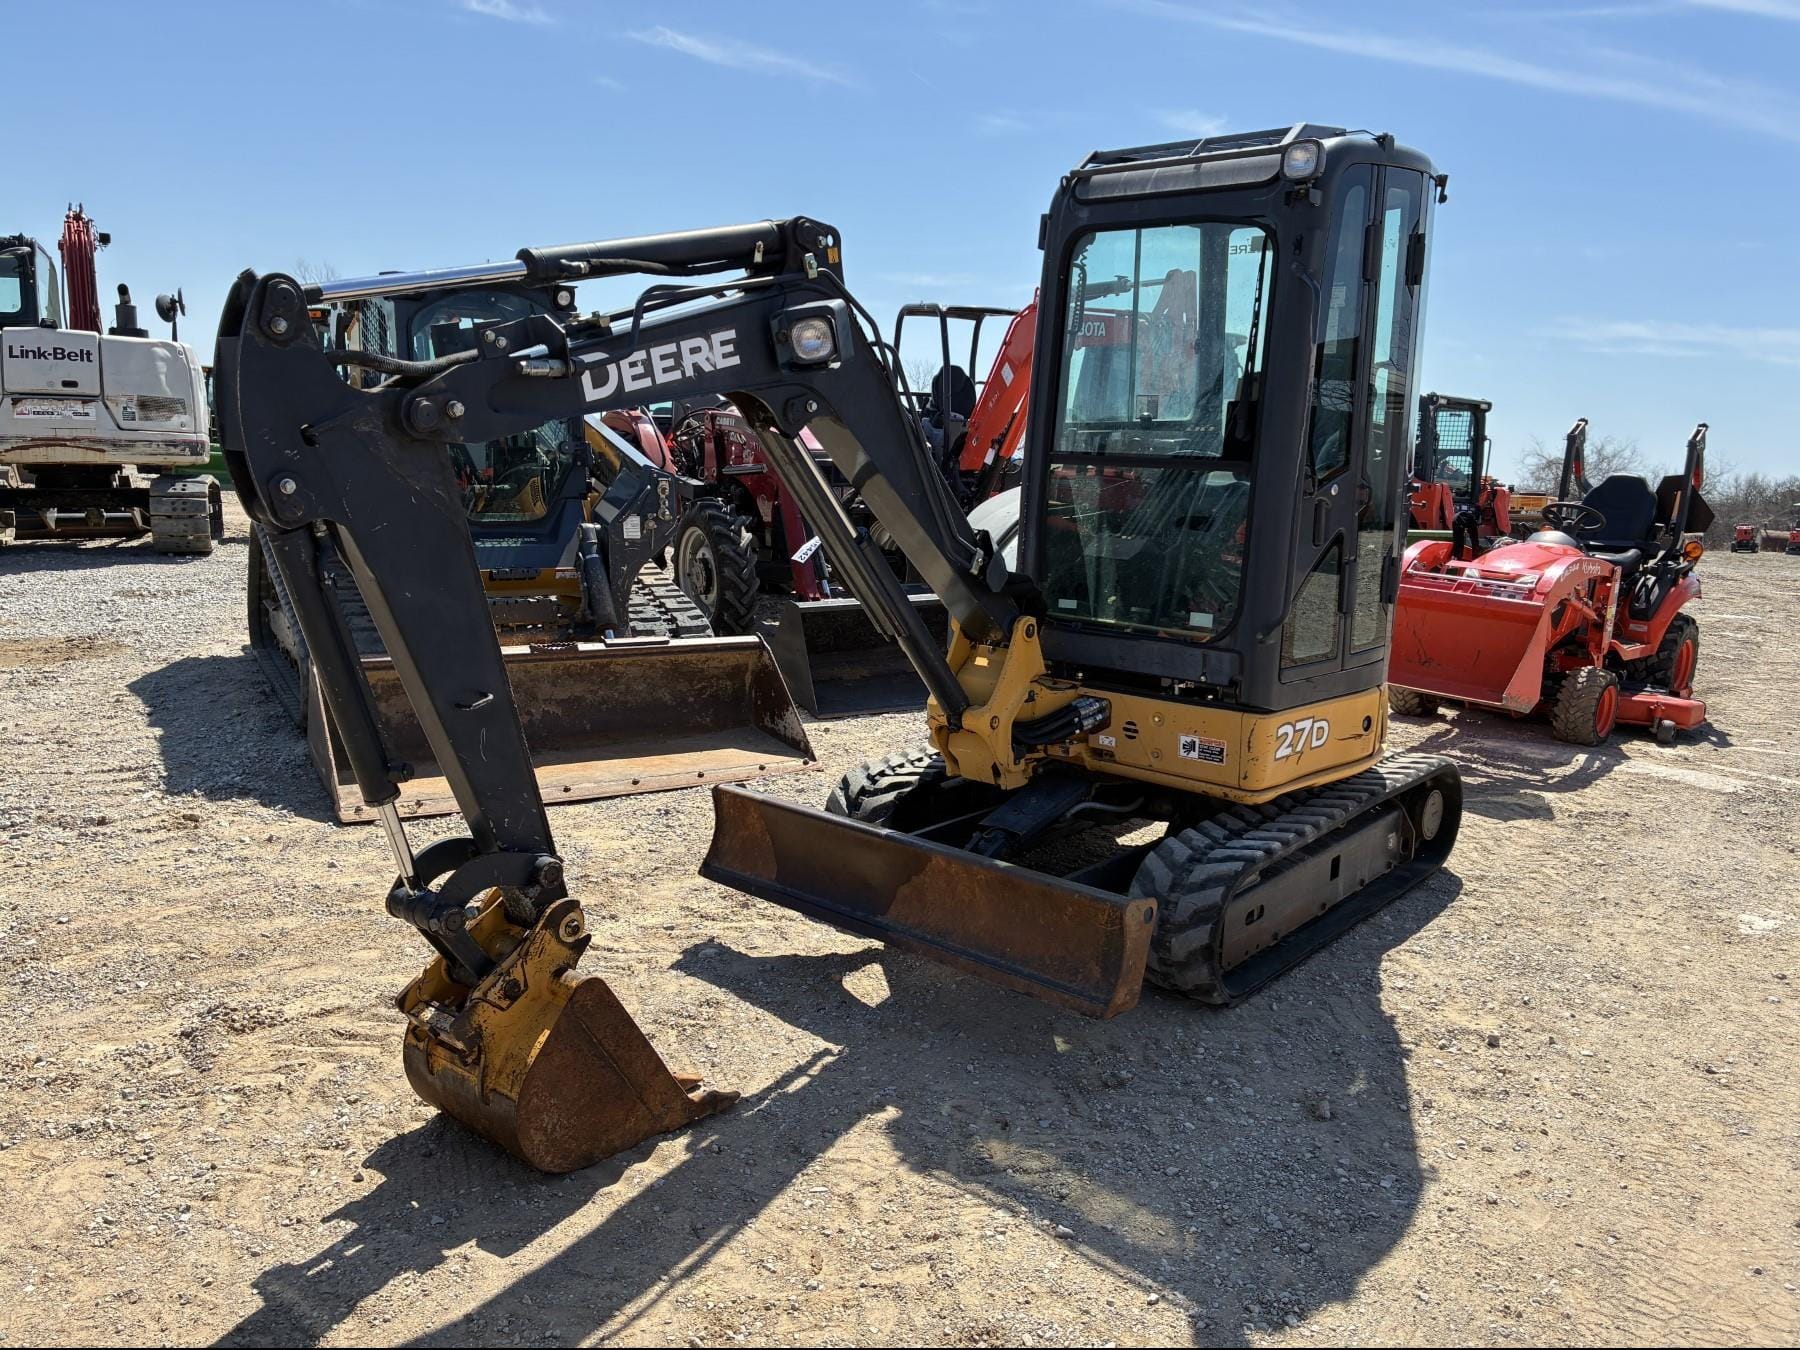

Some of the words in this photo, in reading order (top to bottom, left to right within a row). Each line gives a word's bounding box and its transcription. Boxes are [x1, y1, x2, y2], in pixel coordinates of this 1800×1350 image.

[8, 344, 93, 363] Link-Belt
[580, 329, 741, 402] DEERE
[1274, 716, 1330, 762] 27D
